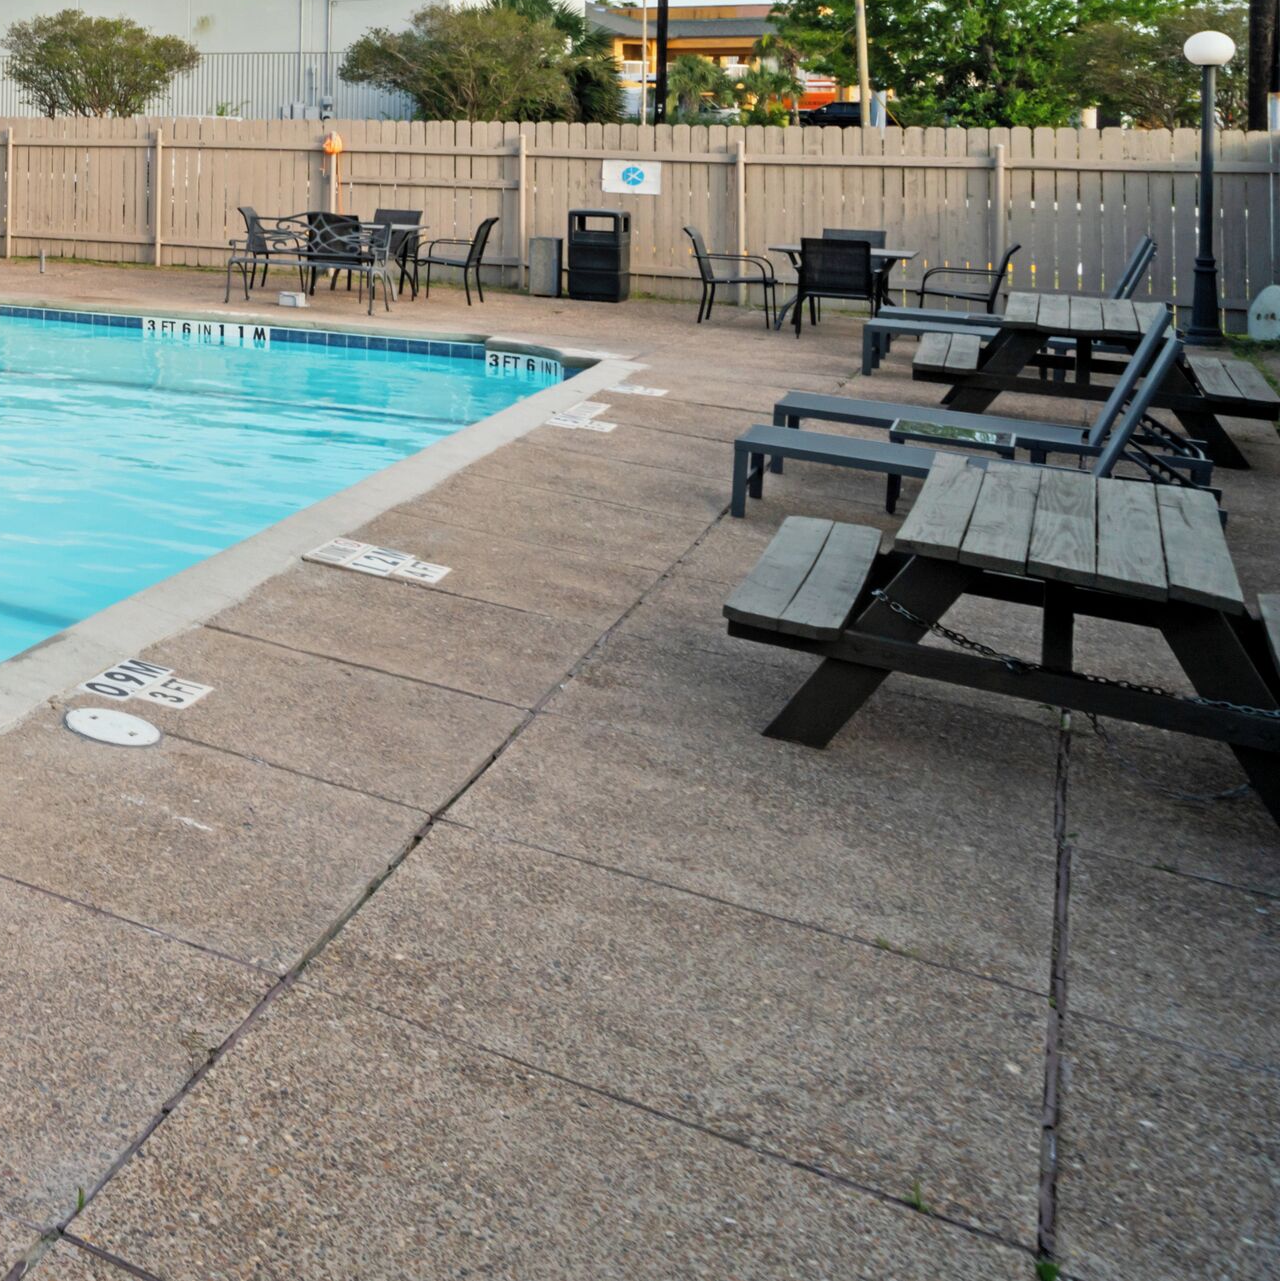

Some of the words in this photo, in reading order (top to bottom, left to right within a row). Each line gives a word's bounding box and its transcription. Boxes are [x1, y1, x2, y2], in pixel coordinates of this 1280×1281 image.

[147, 319, 156, 332] 3
[161, 320, 176, 333] FT
[182, 321, 191, 334] 6
[197, 323, 212, 336] IN
[253, 326, 266, 341] M
[488, 353, 500, 367] 3
[502, 355, 520, 369] FT
[526, 358, 536, 372] 6
[541, 359, 552, 375] IN
